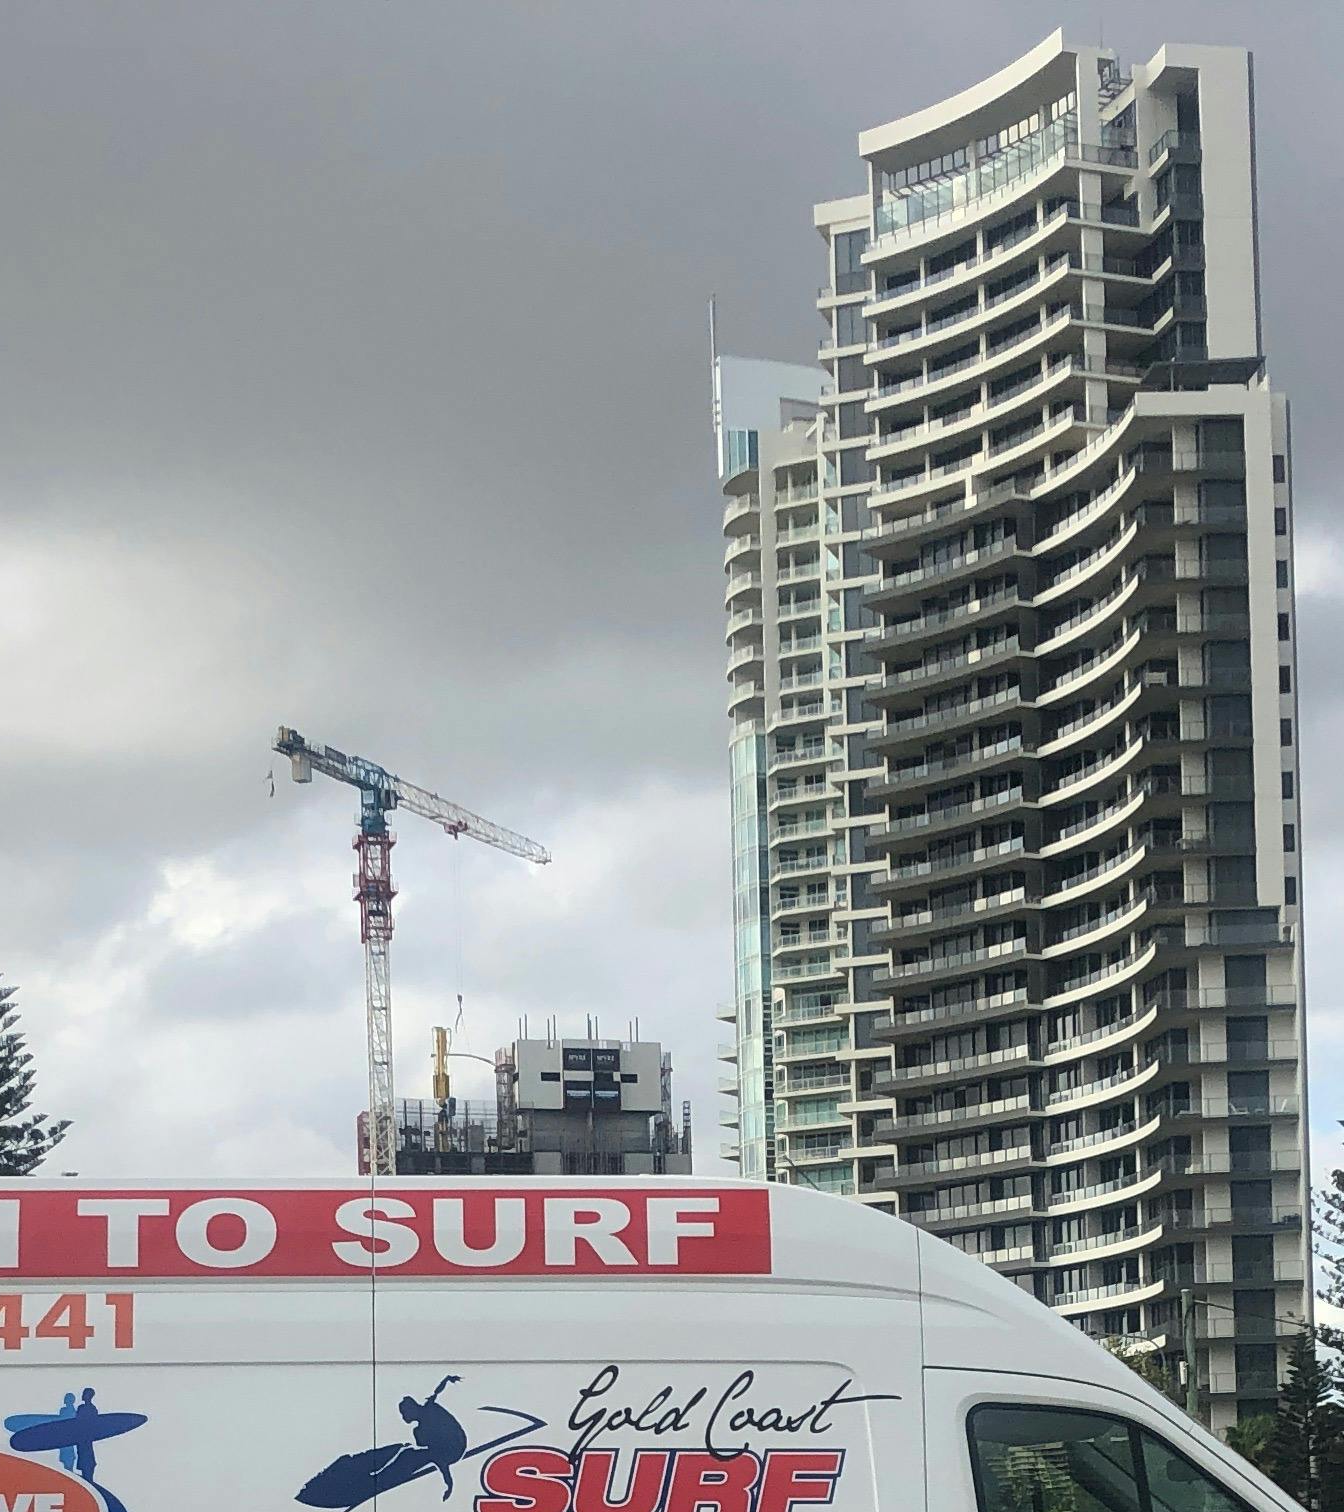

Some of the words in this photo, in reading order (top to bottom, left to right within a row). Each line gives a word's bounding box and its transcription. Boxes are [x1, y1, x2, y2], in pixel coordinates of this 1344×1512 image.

[77, 1197, 277, 1269] TO
[331, 1196, 720, 1268] SURF
[567, 1364, 708, 1464] Gold
[705, 1369, 903, 1462] Coast
